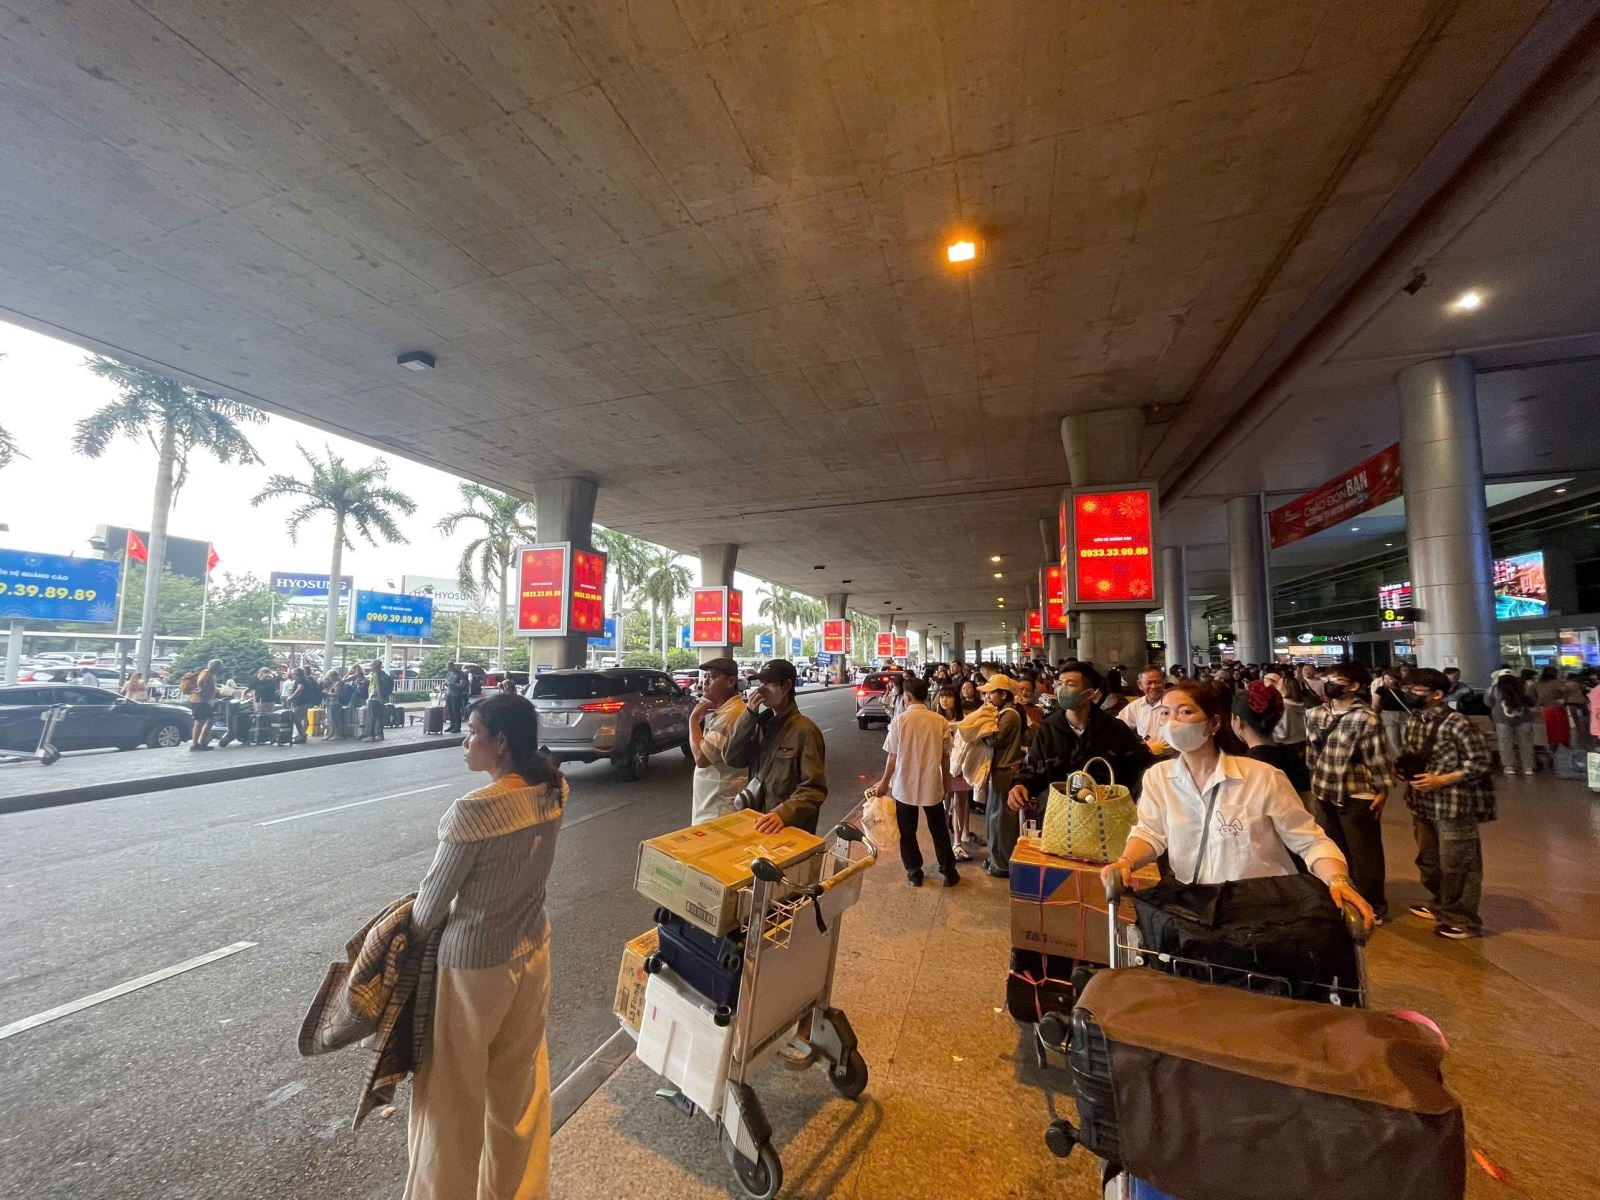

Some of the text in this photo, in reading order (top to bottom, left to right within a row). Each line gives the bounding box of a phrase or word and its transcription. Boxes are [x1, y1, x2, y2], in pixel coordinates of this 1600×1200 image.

[276, 578, 347, 590] HYOSUG
[366, 612, 424, 624] 0969.39.89.89
[1384, 609, 1395, 621] 8
